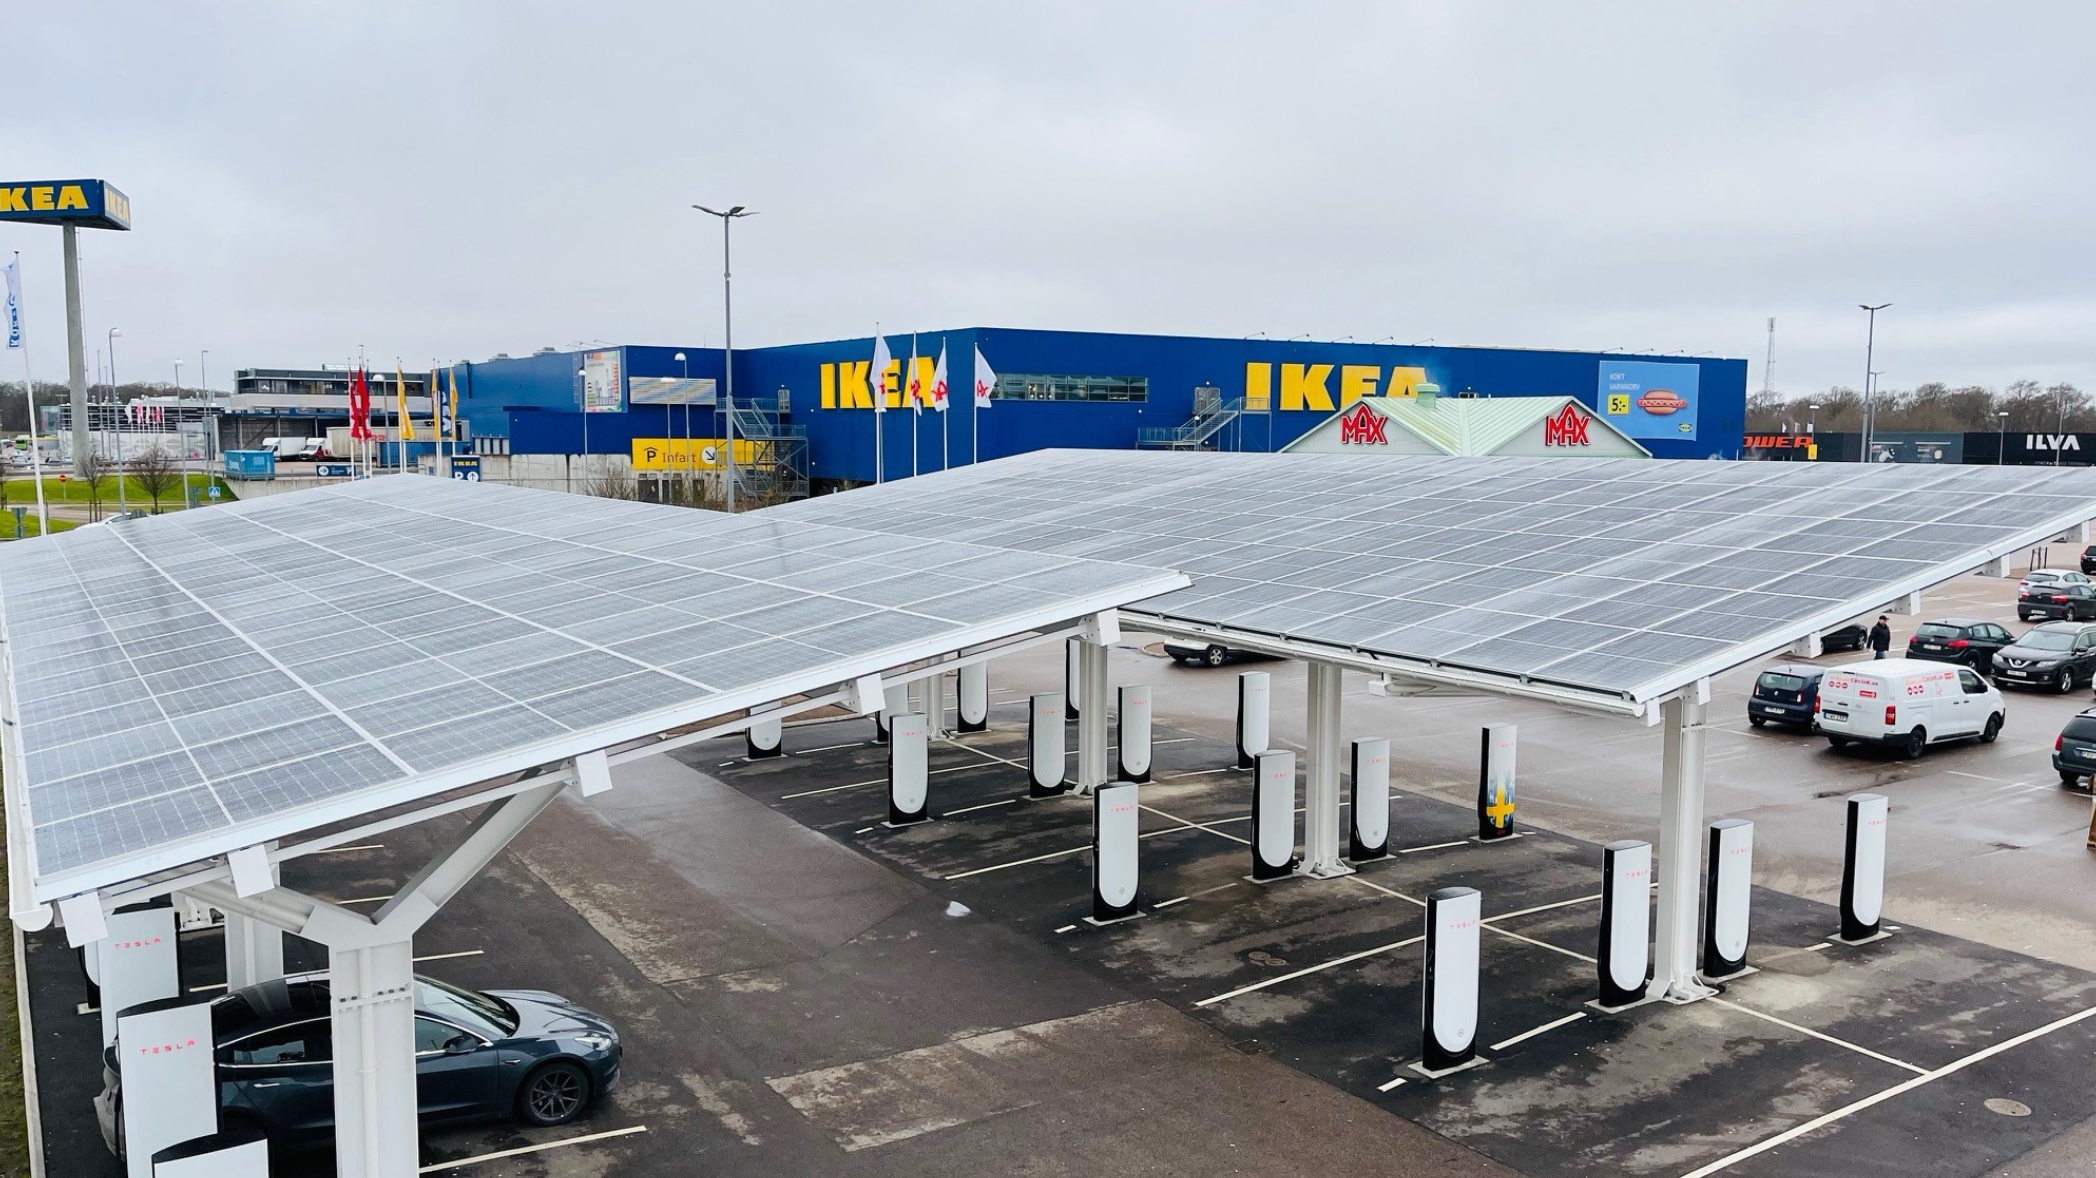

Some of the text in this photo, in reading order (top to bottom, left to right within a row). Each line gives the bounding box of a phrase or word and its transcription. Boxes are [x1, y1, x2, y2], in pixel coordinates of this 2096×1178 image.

[0, 185, 89, 212] KEA
[1245, 363, 1428, 412] IKEA
[1611, 397, 1626, 412] 5:-
[1340, 404, 1387, 444] MAX
[1546, 404, 1591, 445] MAX
[1743, 436, 1813, 448] OWER
[2026, 434, 2081, 451] ILVA
[647, 450, 657, 463] P
[113, 936, 162, 950] TESLA
[139, 1037, 196, 1056] TESLA
